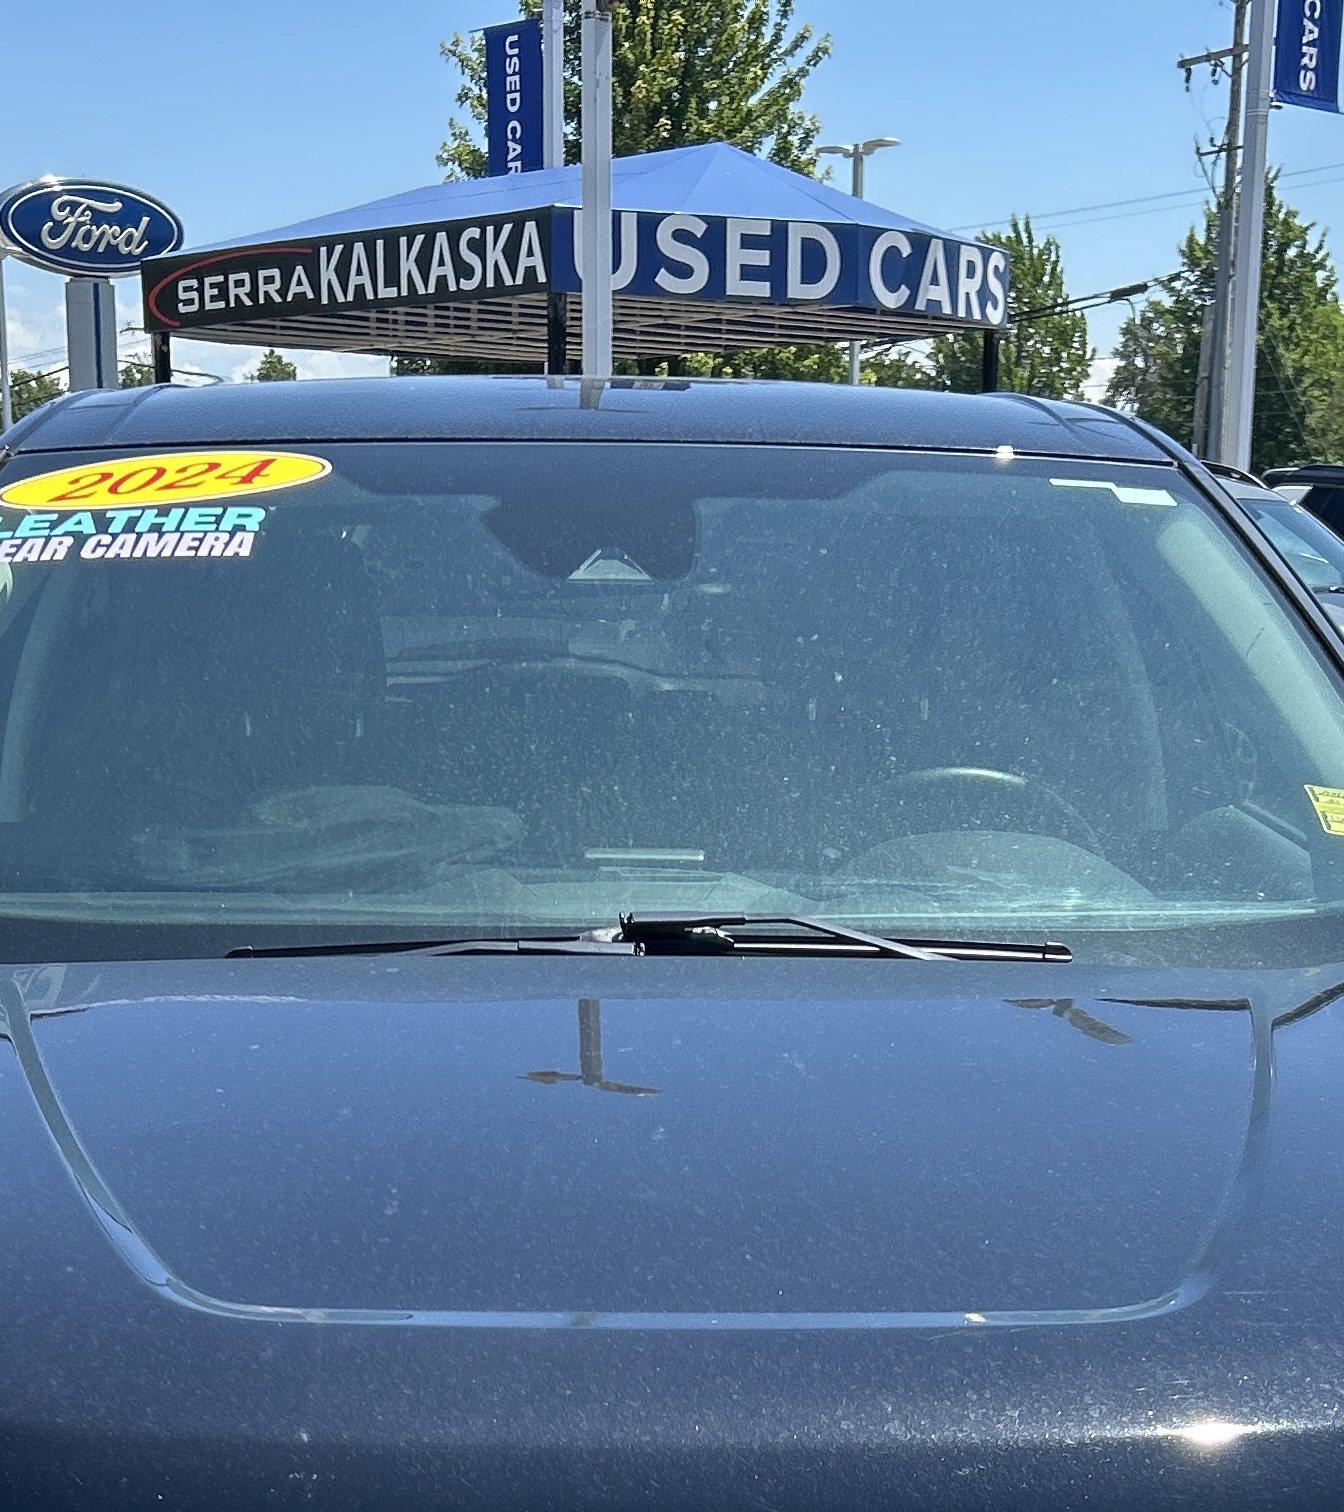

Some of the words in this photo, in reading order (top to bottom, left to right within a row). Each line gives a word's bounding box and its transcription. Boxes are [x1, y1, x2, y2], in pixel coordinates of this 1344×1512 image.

[505, 34, 521, 113] USED
[1299, 0, 1320, 90] CARS
[41, 194, 151, 255] Ford
[177, 265, 315, 313] SERRA
[319, 220, 548, 305] KALKASKA
[572, 208, 843, 301] USED
[868, 230, 1007, 326] CARS
[47, 459, 277, 502] 2024
[79, 530, 256, 560] CAMERA
